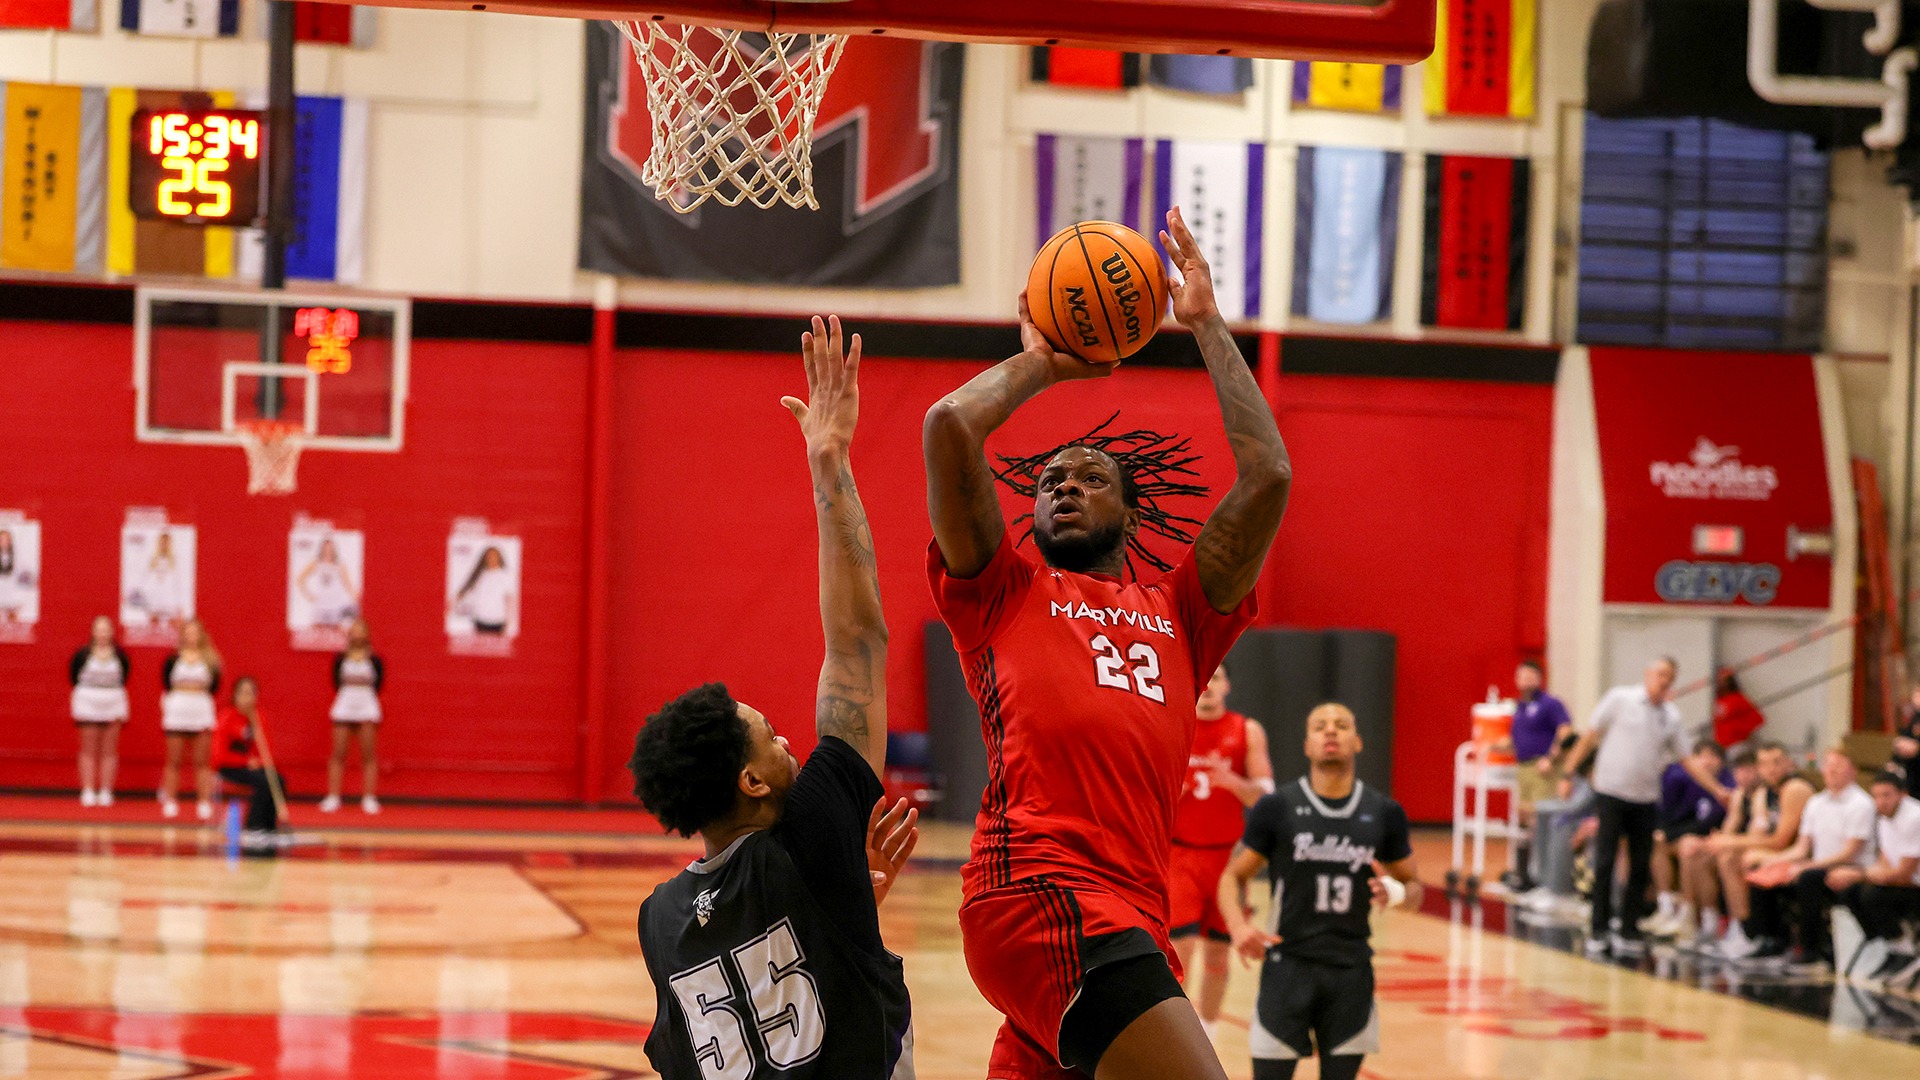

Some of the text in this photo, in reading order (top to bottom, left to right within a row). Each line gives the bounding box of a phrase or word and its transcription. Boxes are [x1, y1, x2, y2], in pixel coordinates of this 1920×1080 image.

[150, 113, 258, 160] 15:34
[158, 156, 231, 217] 25
[1065, 286, 1101, 347] NCAA
[1101, 251, 1141, 344] Wilson
[1050, 599, 1176, 640] MARYVILLE
[1089, 631, 1167, 706] 22
[1192, 770, 1211, 800] 3
[1315, 874, 1353, 914] 13
[668, 916, 826, 1080] 55
